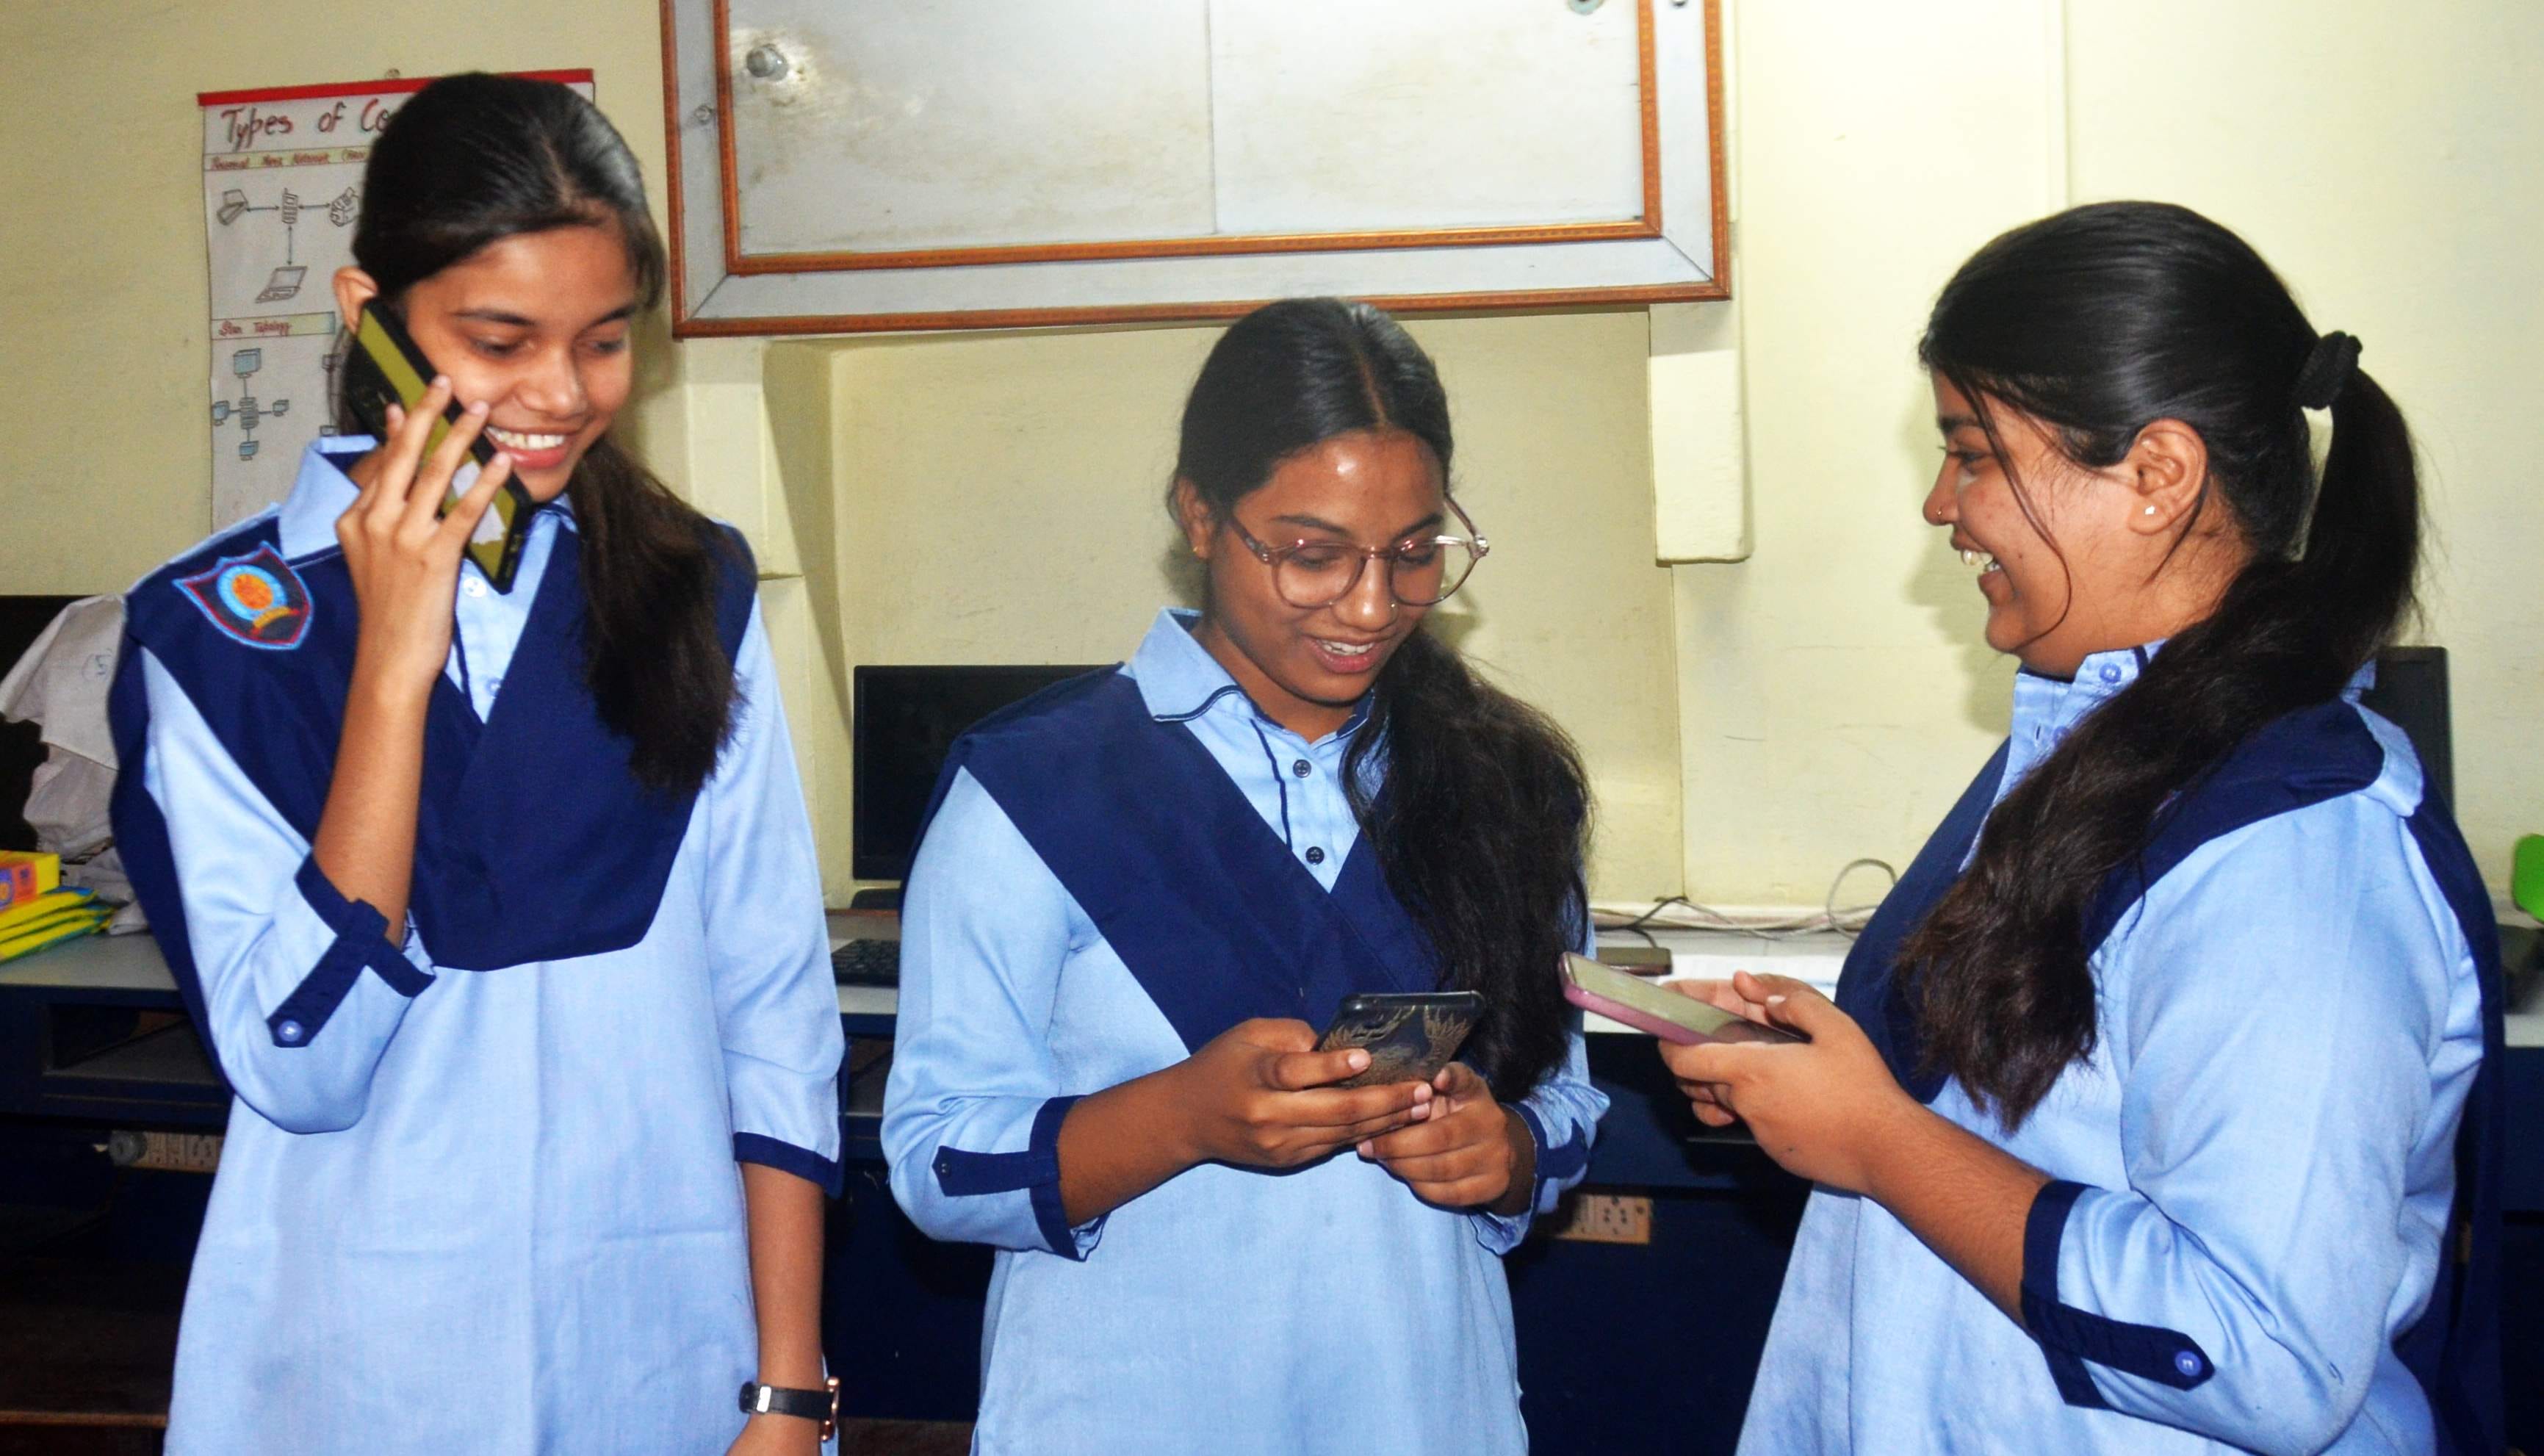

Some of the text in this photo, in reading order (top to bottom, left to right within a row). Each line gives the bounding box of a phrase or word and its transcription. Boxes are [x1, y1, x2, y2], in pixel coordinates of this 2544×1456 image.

[221, 98, 390, 152] Types of Co
